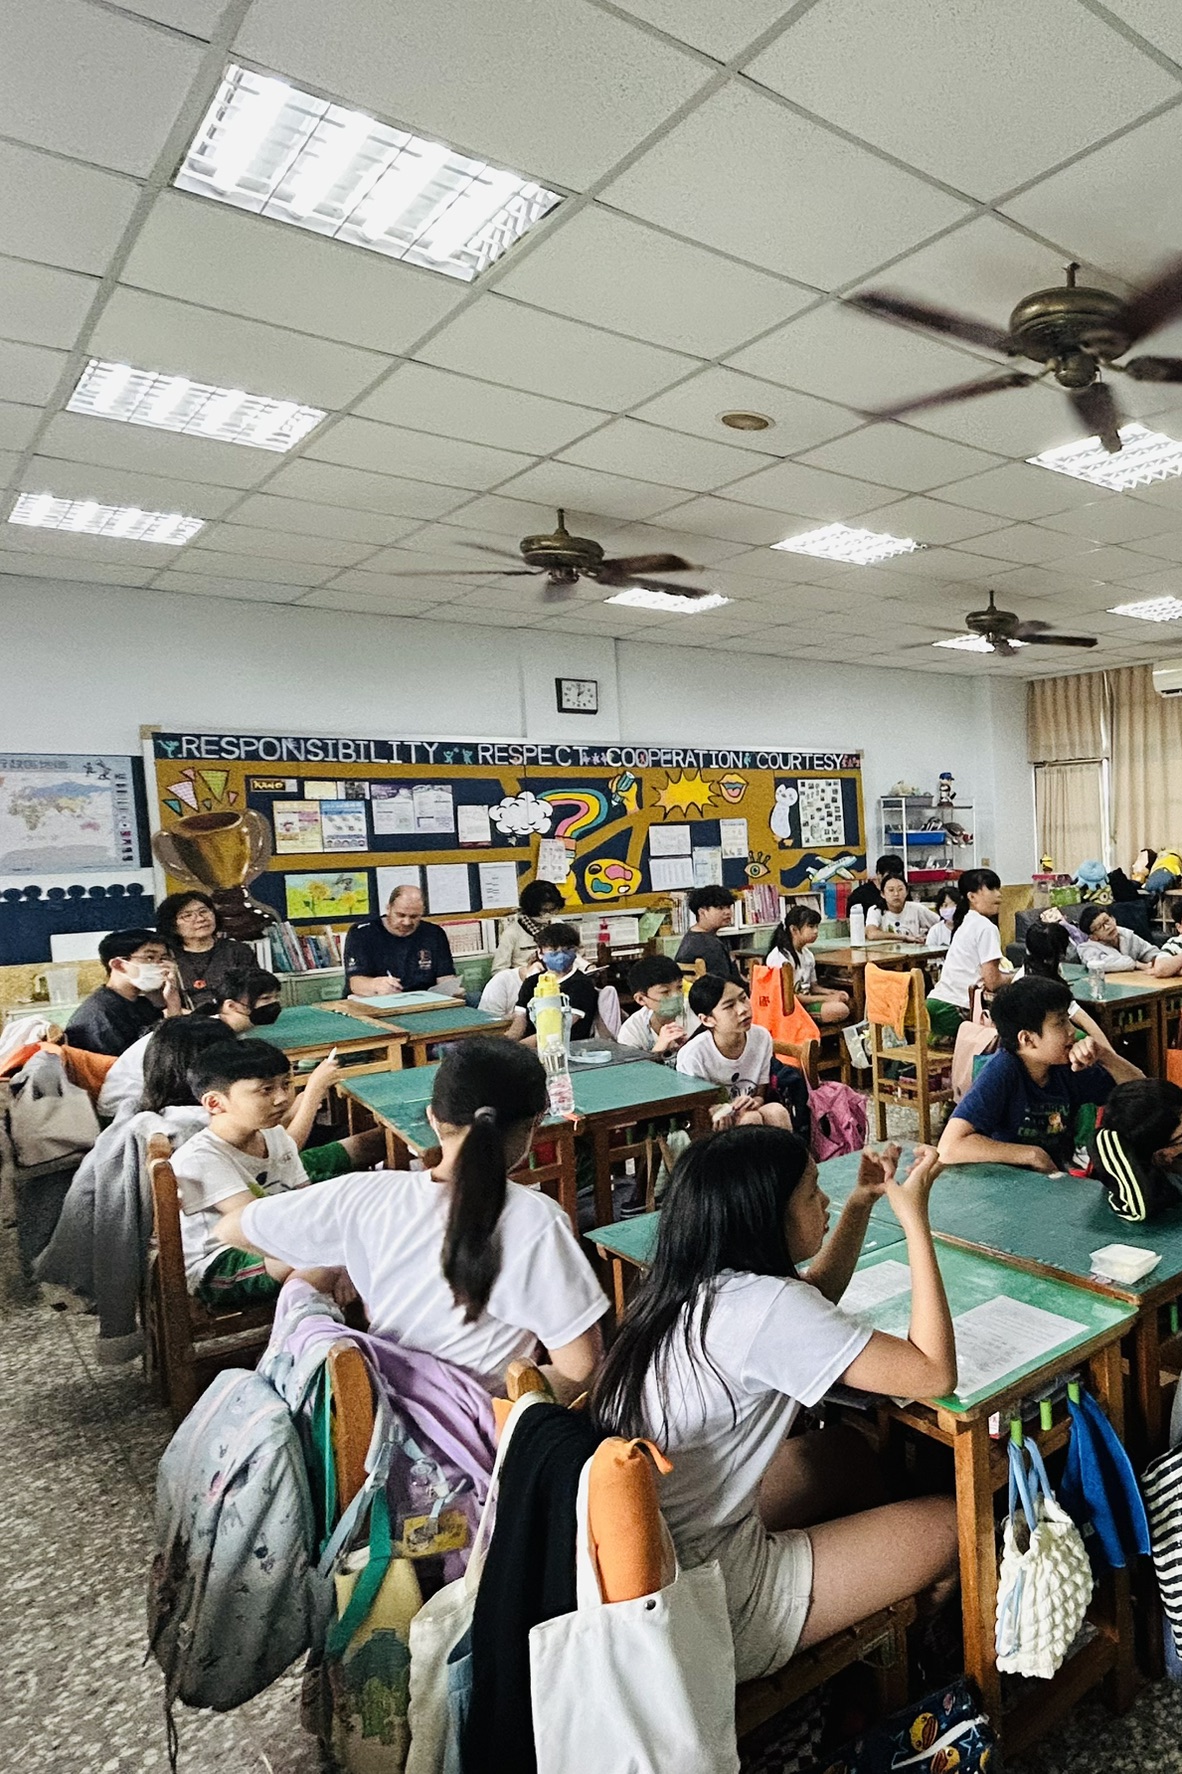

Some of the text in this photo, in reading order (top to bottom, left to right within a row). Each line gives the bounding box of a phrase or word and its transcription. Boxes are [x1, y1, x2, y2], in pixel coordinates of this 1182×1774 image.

[181, 736, 844, 771] RESPONSIBILITY RESPECT COOPERATION COURTESY
